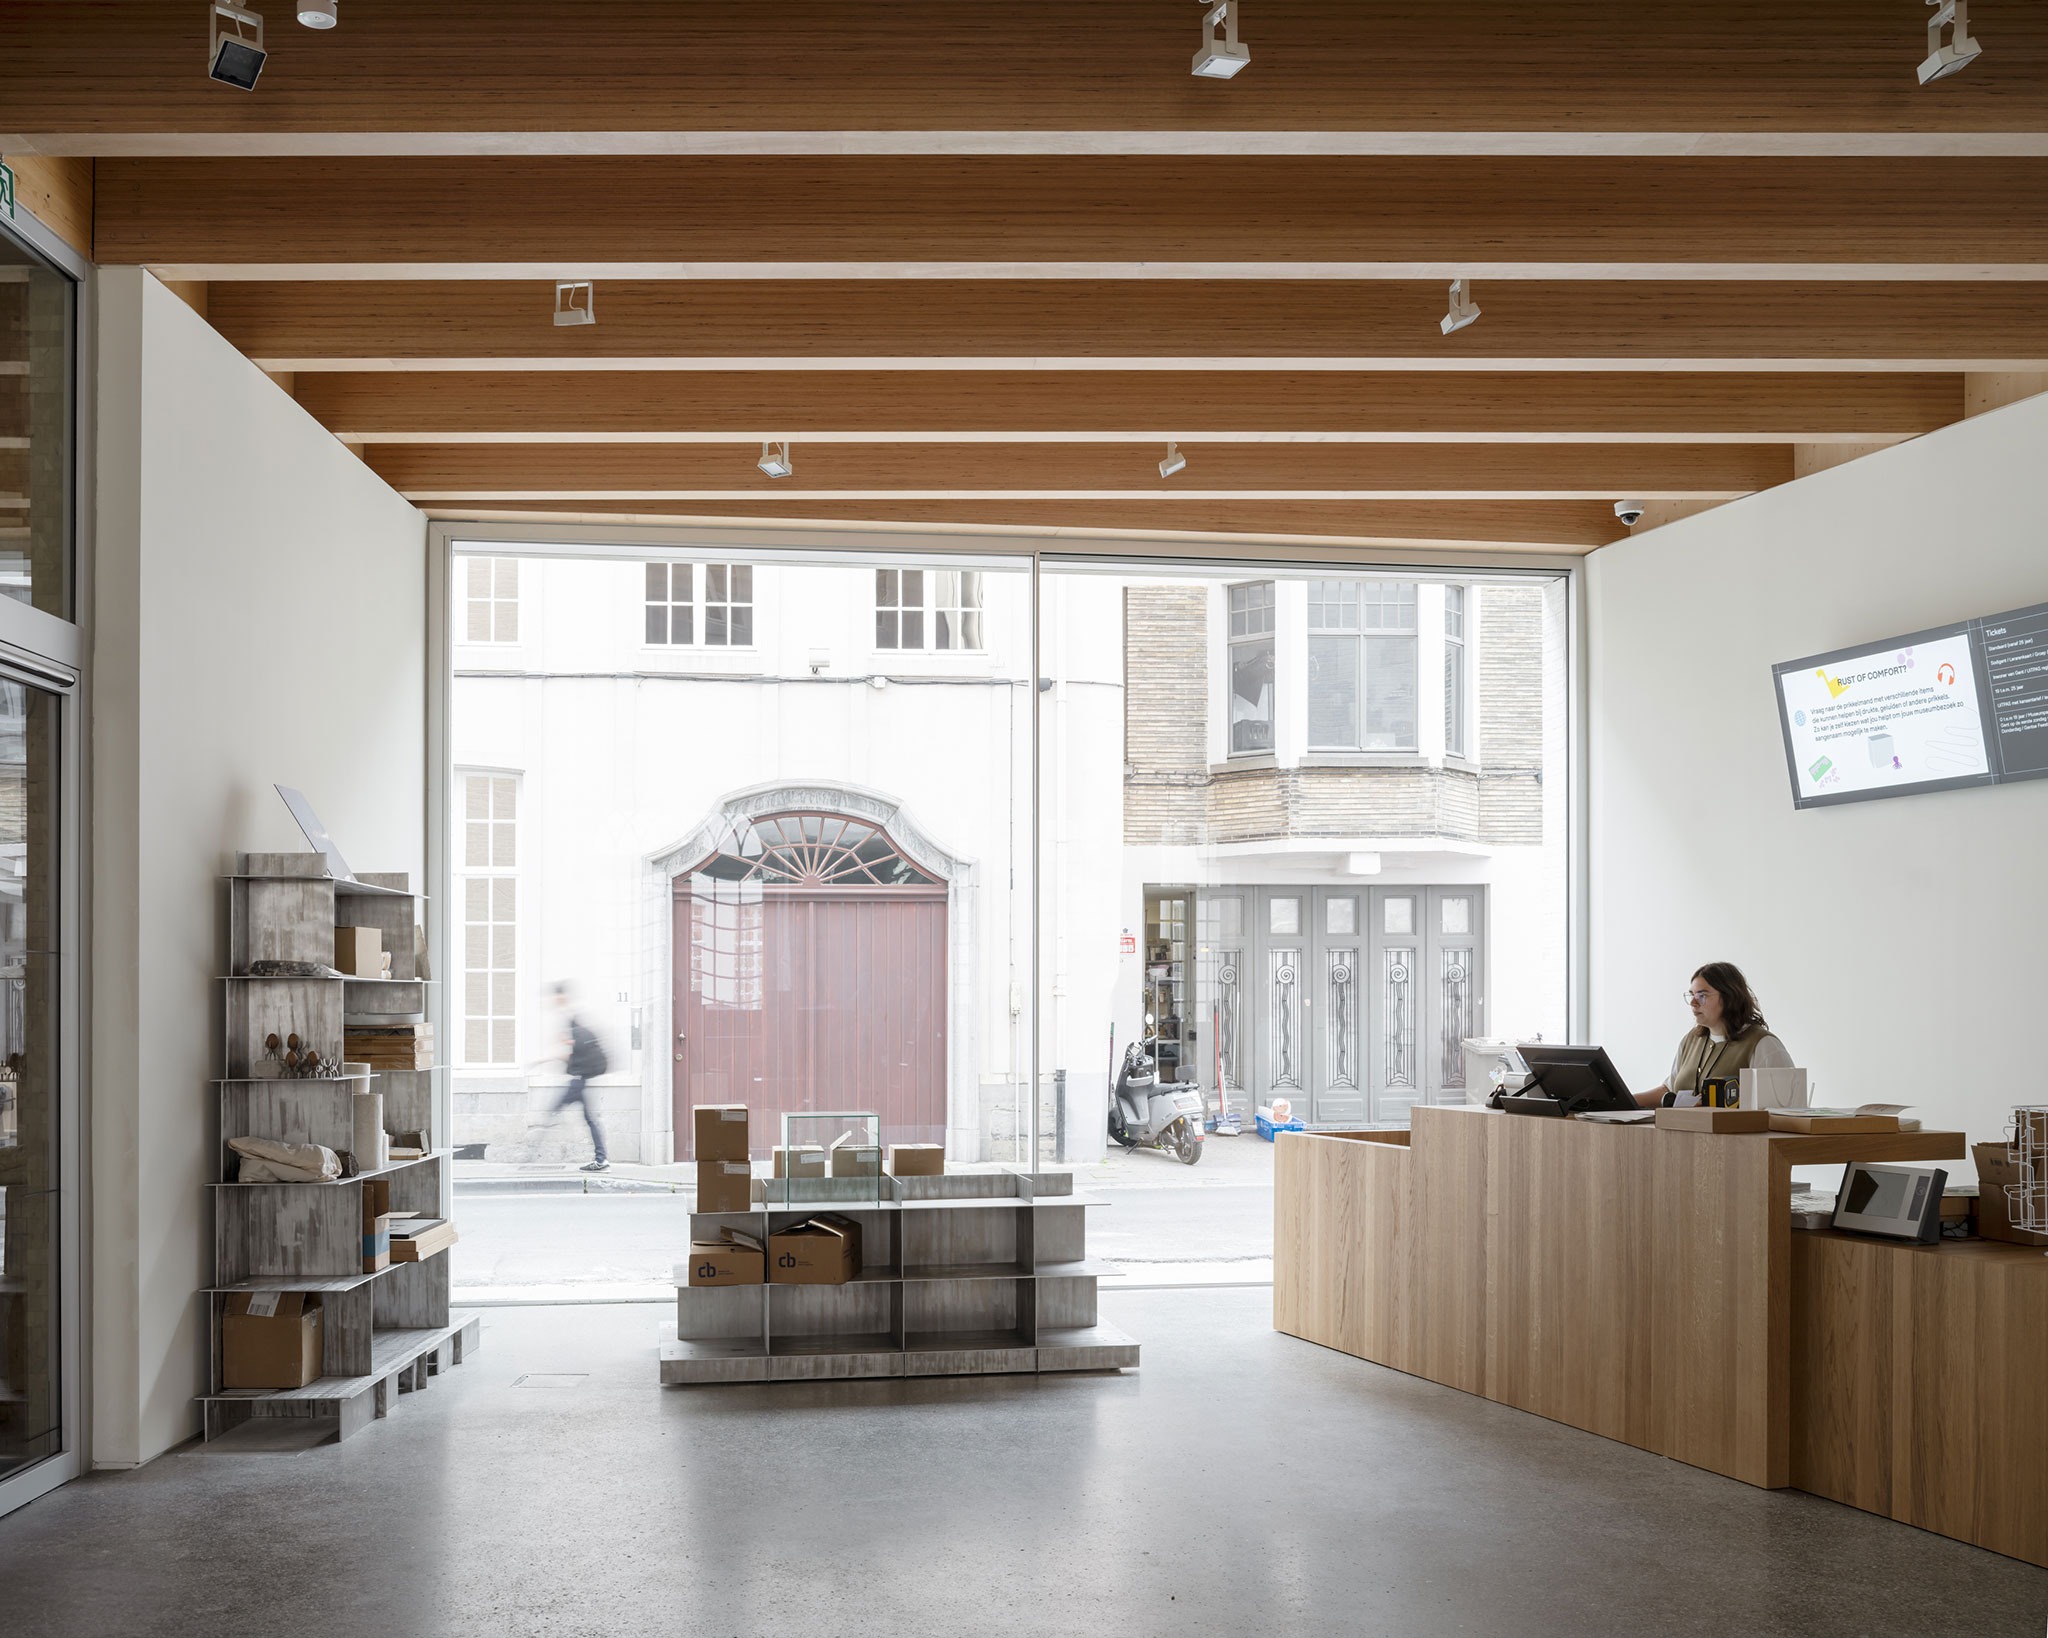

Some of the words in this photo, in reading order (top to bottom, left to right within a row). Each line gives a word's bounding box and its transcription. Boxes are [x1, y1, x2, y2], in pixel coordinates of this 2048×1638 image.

[1986, 628, 2006, 637] Tickets
[1837, 675, 1856, 686] RUST
[1857, 673, 1867, 682] OF
[1867, 665, 1907, 680] COMFORT?
[1838, 711, 1855, 720] helpen
[1880, 702, 1902, 712] geluiden
[1928, 694, 1950, 702] prikkels.
[1844, 698, 1873, 709] prikkelmand
[1885, 690, 1918, 701] verschillende
[1914, 702, 1956, 714] museumbezoek
[1815, 732, 1842, 742] aangenaam
[1843, 729, 1863, 737] mogelijk
[617, 992, 628, 1002] 11
[778, 1252, 796, 1268] cb
[698, 1262, 716, 1278] cb
